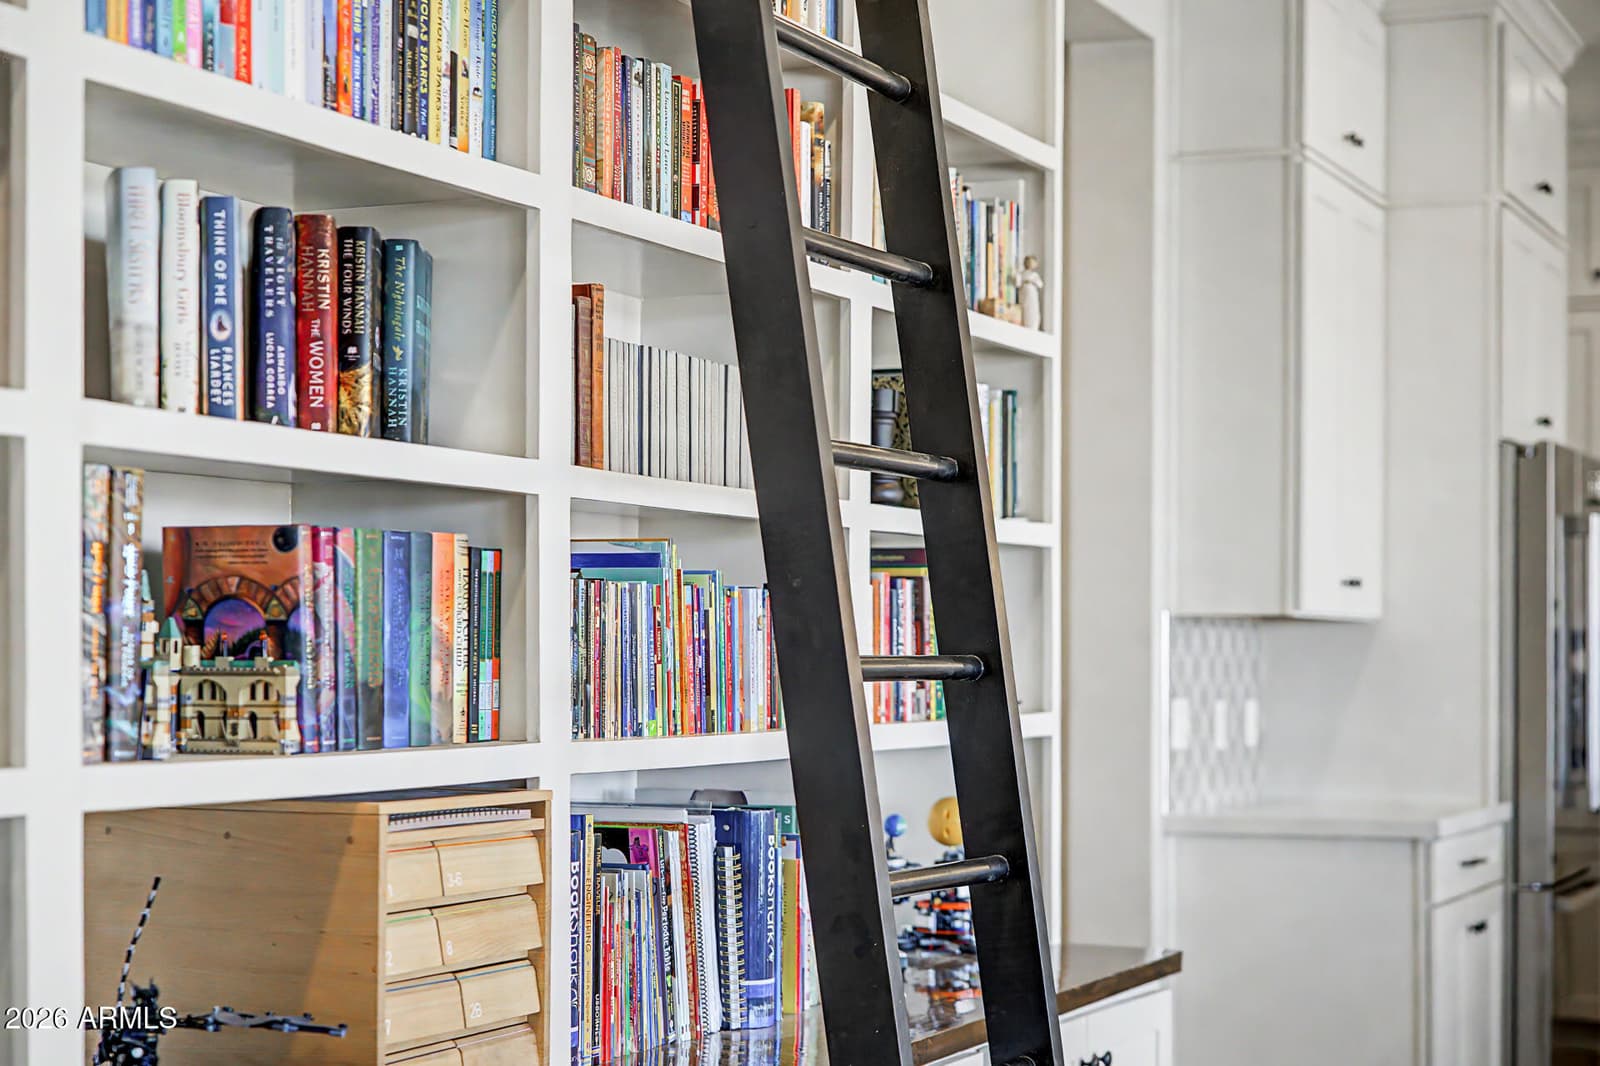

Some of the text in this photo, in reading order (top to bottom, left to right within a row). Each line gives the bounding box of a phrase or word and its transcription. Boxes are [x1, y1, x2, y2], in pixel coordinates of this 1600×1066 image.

[420, 45, 429, 94] SPARKS
[213, 209, 227, 305] THINK OF ME
[264, 225, 275, 318] TRAVELERS
[276, 256, 286, 308] NIGHT
[301, 245, 315, 312] HANNAH
[316, 248, 330, 310] KRISTIN
[342, 238, 354, 335] THE FOUR WINDS
[353, 239, 367, 335] KRISTIN HANNAH
[392, 256, 406, 342] The Nightingale
[209, 348, 222, 405] LIARDET
[222, 346, 234, 407] FRANCES
[265, 332, 274, 365] LUCAS
[276, 345, 286, 395] ARMANDO
[309, 318, 325, 408] THE WOMEN
[388, 366, 397, 428] HANNAH
[397, 366, 407, 427] KRISTIN
[783, 814, 791, 824] S
[584, 877, 592, 953] ENGINEERING
[661, 905, 670, 947] Periodic
[663, 947, 672, 972] Table
